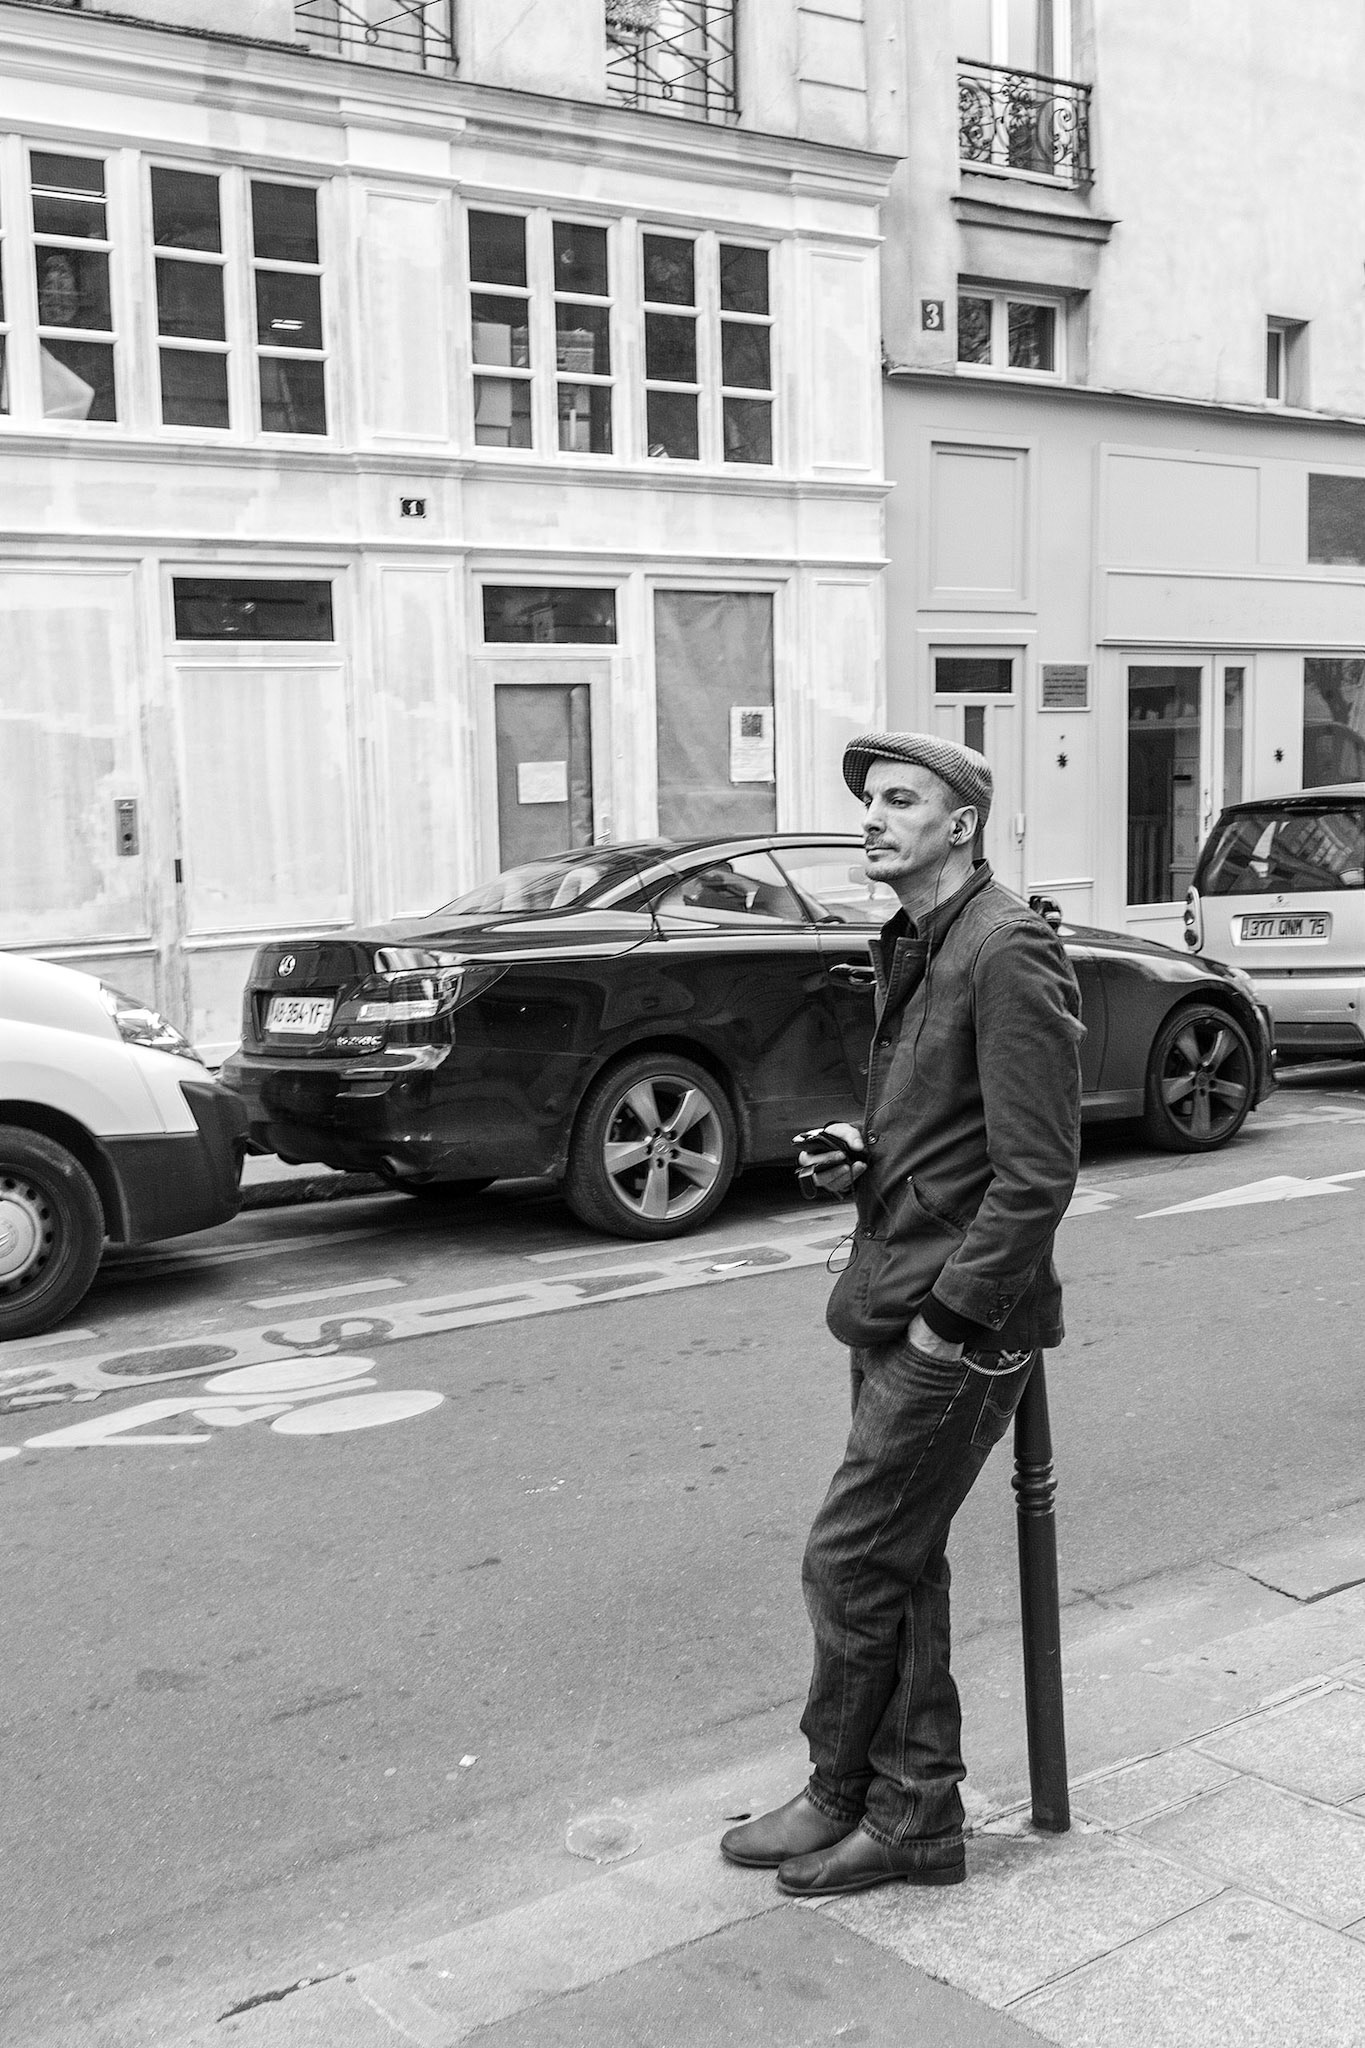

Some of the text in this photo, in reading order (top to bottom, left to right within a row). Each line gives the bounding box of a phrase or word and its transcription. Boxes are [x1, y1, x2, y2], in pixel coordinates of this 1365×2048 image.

[926, 303, 940, 329] 3
[408, 500, 418, 515] 1
[1250, 920, 1275, 937] 377
[1309, 918, 1325, 935] 75
